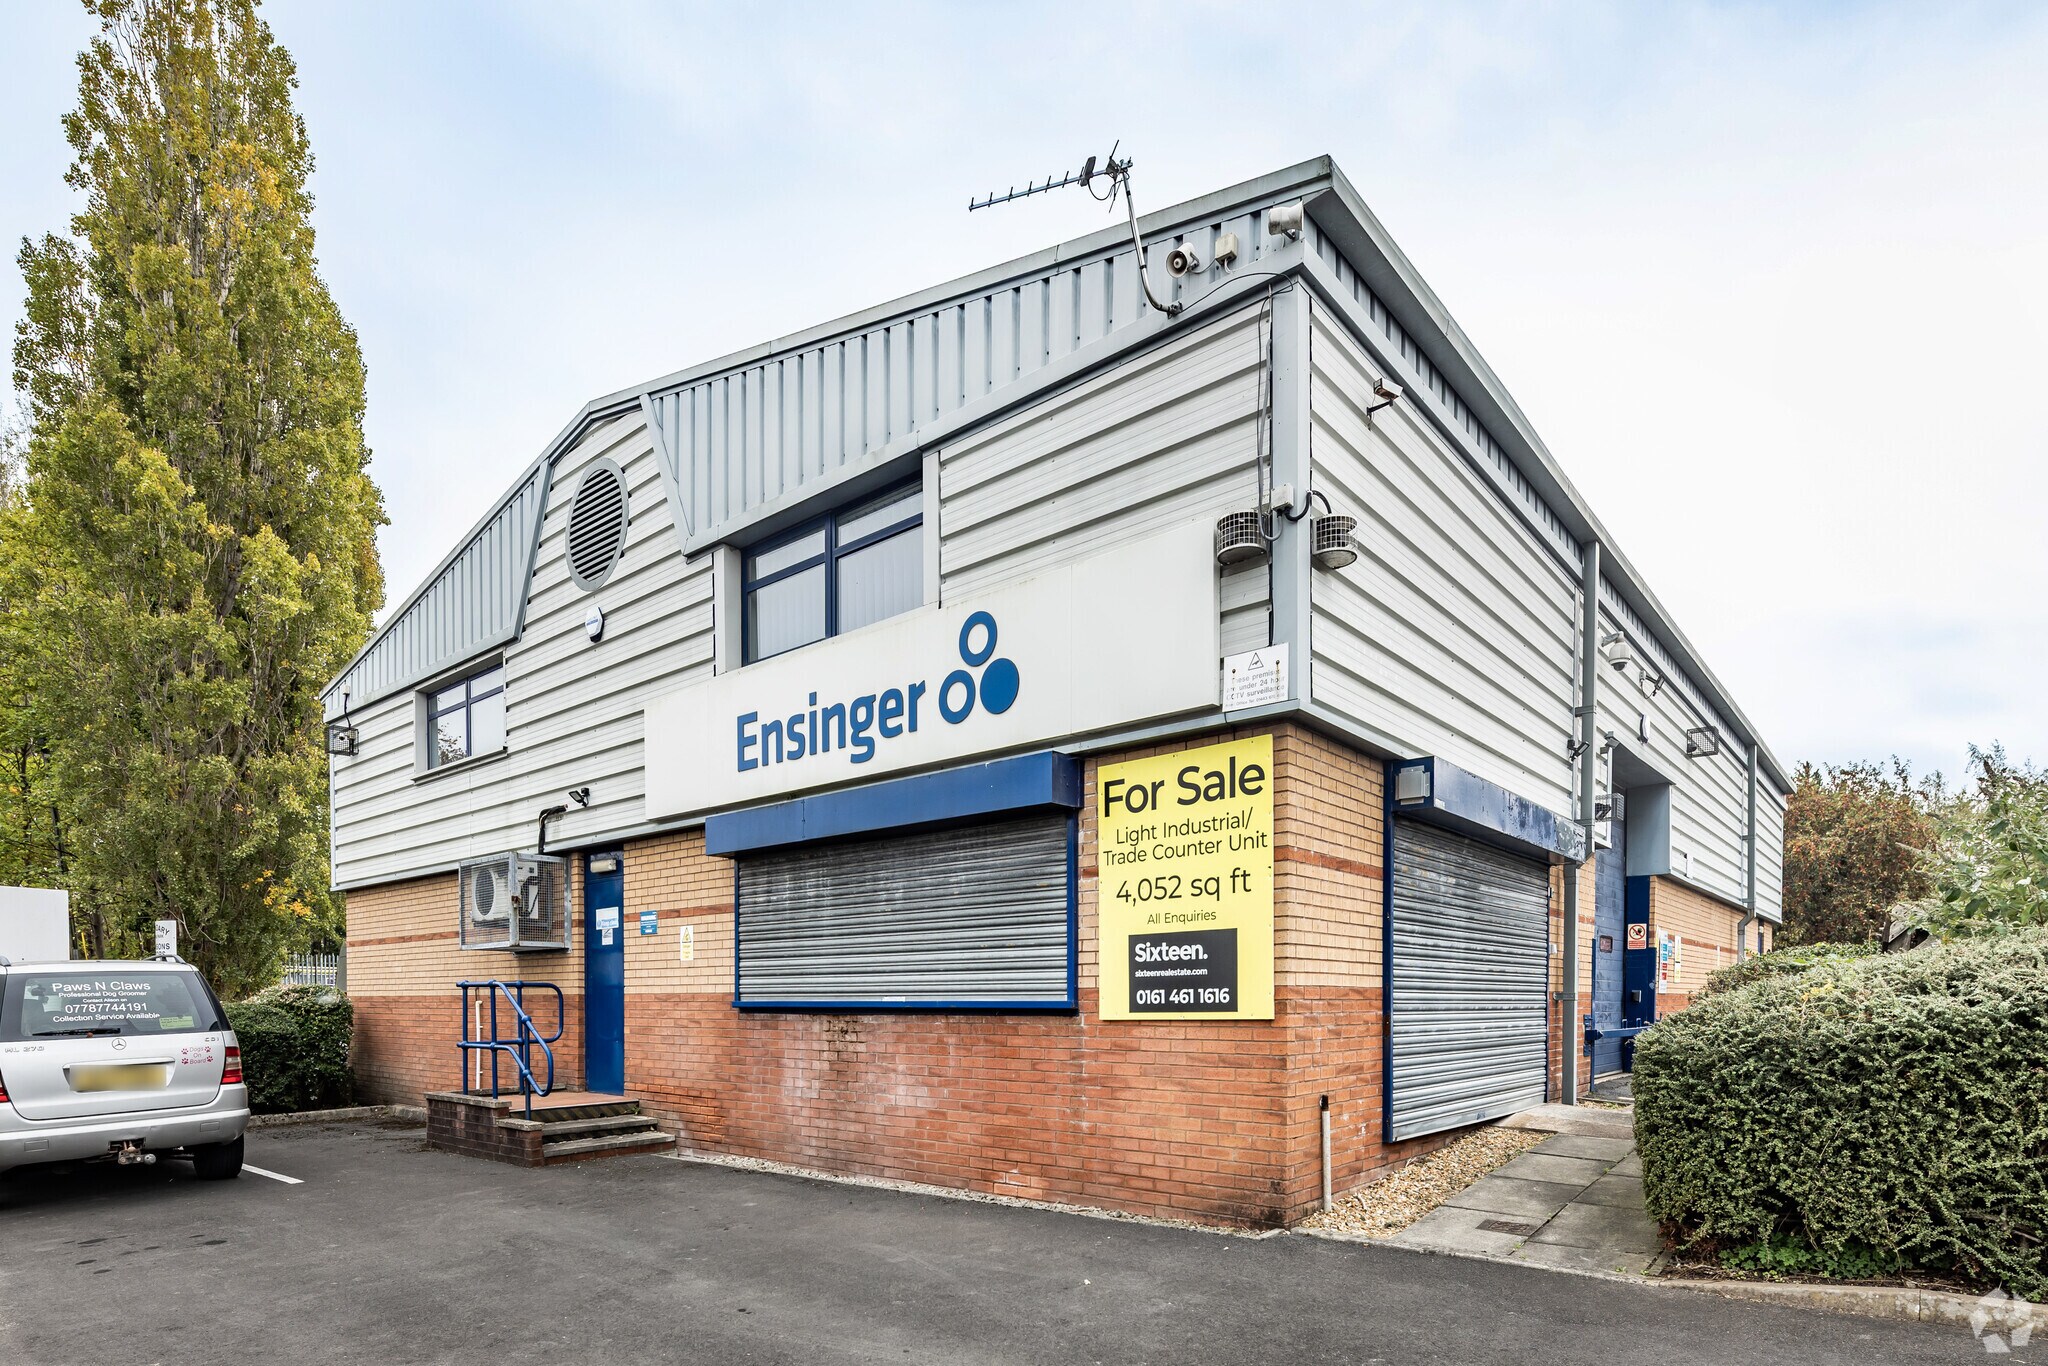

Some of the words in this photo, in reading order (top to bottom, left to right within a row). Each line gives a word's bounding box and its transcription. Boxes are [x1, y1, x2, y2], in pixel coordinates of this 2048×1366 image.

[1239, 682, 1257, 690] under
[1271, 676, 1285, 684] hor
[737, 680, 926, 772] Ensinger
[1104, 779, 1165, 817] For
[1176, 756, 1266, 806] Sale
[1116, 825, 1158, 846] Light
[1163, 807, 1253, 839] Industrial/
[1103, 847, 1147, 866] Trade
[1152, 839, 1222, 860] Counter
[1229, 830, 1268, 851] Unit
[1116, 875, 1182, 907] 4,052
[1190, 876, 1220, 901] sq
[1230, 867, 1251, 893] ft
[1147, 913, 1161, 925] All
[1164, 910, 1217, 925] Enquiries
[1134, 942, 1208, 963] Sixteen.
[1135, 968, 1208, 978] sixteenrealestate.com
[52, 983, 91, 992] Paws
[94, 982, 106, 991] N
[110, 981, 151, 990] Claws
[1136, 989, 1165, 1004] 0161
[1169, 989, 1194, 1004] 461
[1198, 988, 1230, 1004] 1616
[65, 1003, 147, 1013] 07787744191
[53, 1014, 93, 1022] Collection
[95, 1013, 124, 1021] Service
